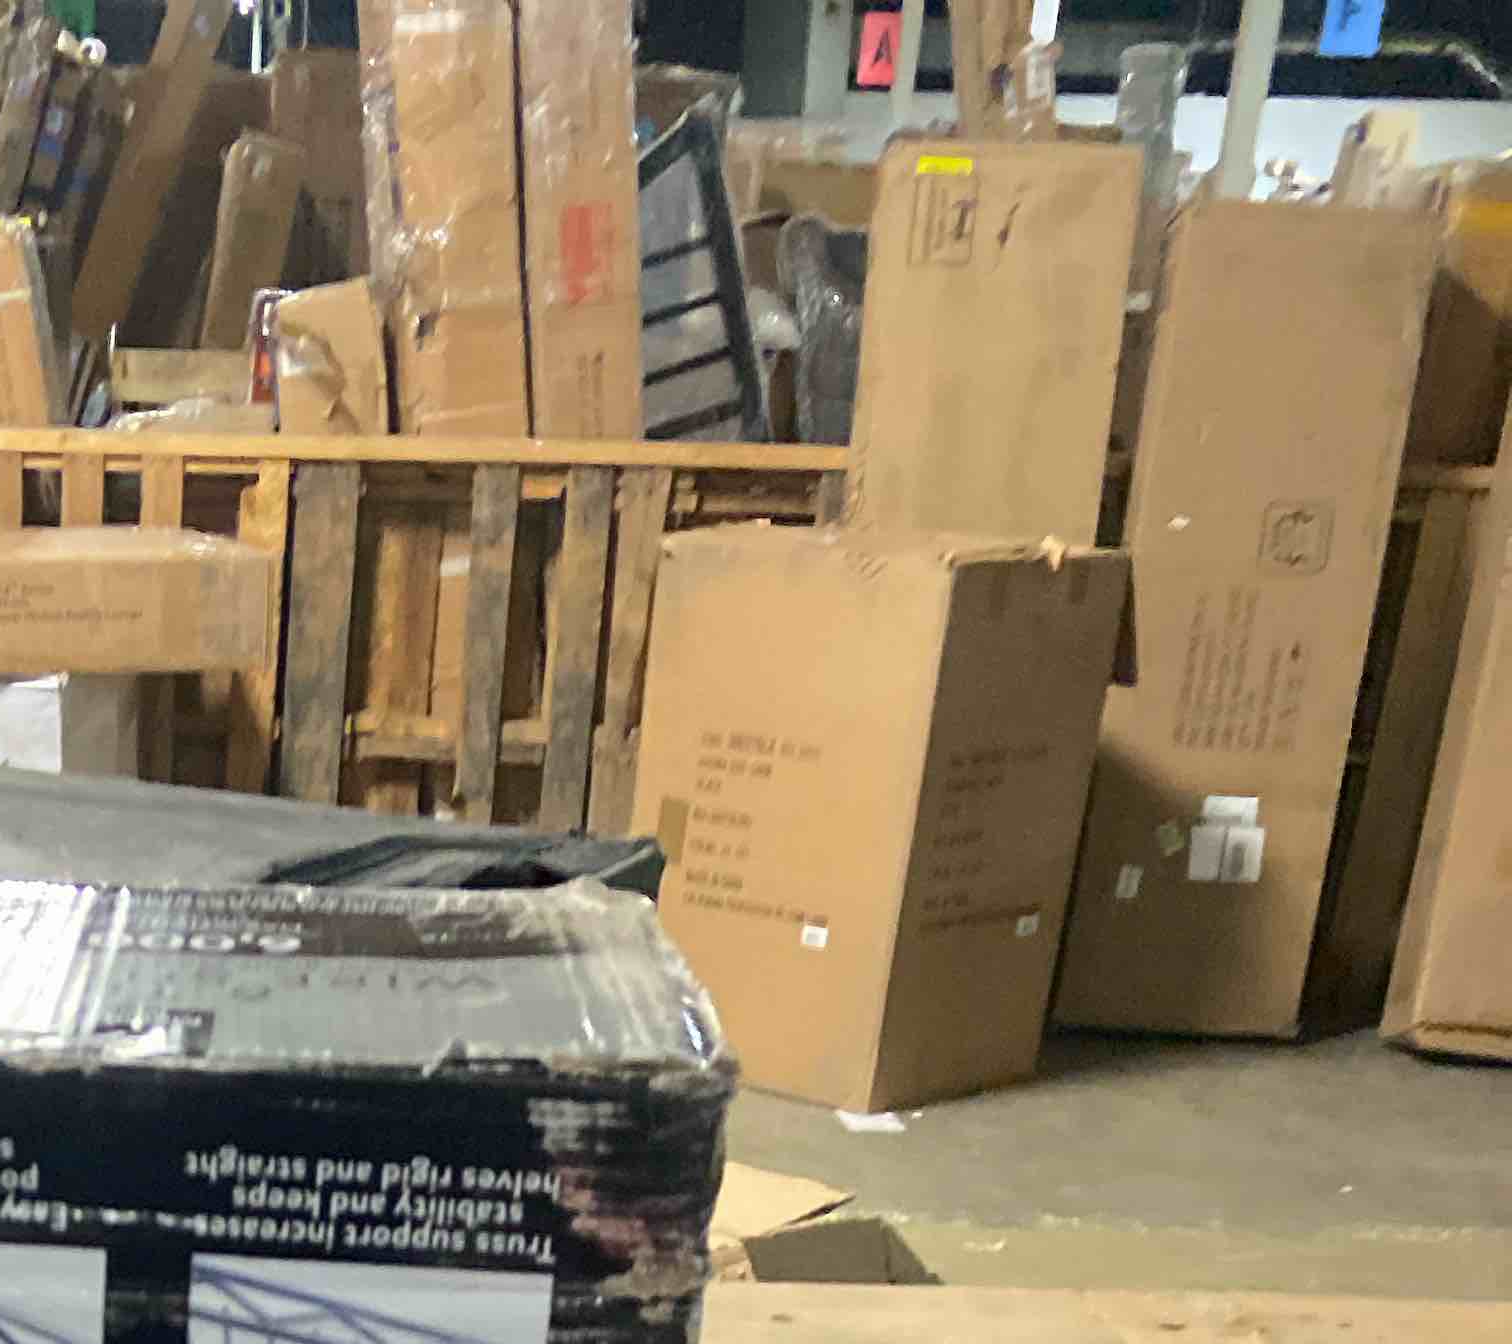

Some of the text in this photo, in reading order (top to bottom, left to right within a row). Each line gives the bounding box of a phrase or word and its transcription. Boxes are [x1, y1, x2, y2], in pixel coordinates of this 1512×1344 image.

[871, 30, 892, 65] A
[183, 1143, 564, 1198] helves rigid and straight
[0, 1193, 69, 1233] Easy
[232, 1182, 525, 1229] stability and keeps
[193, 1212, 556, 1265] Truss support increases
